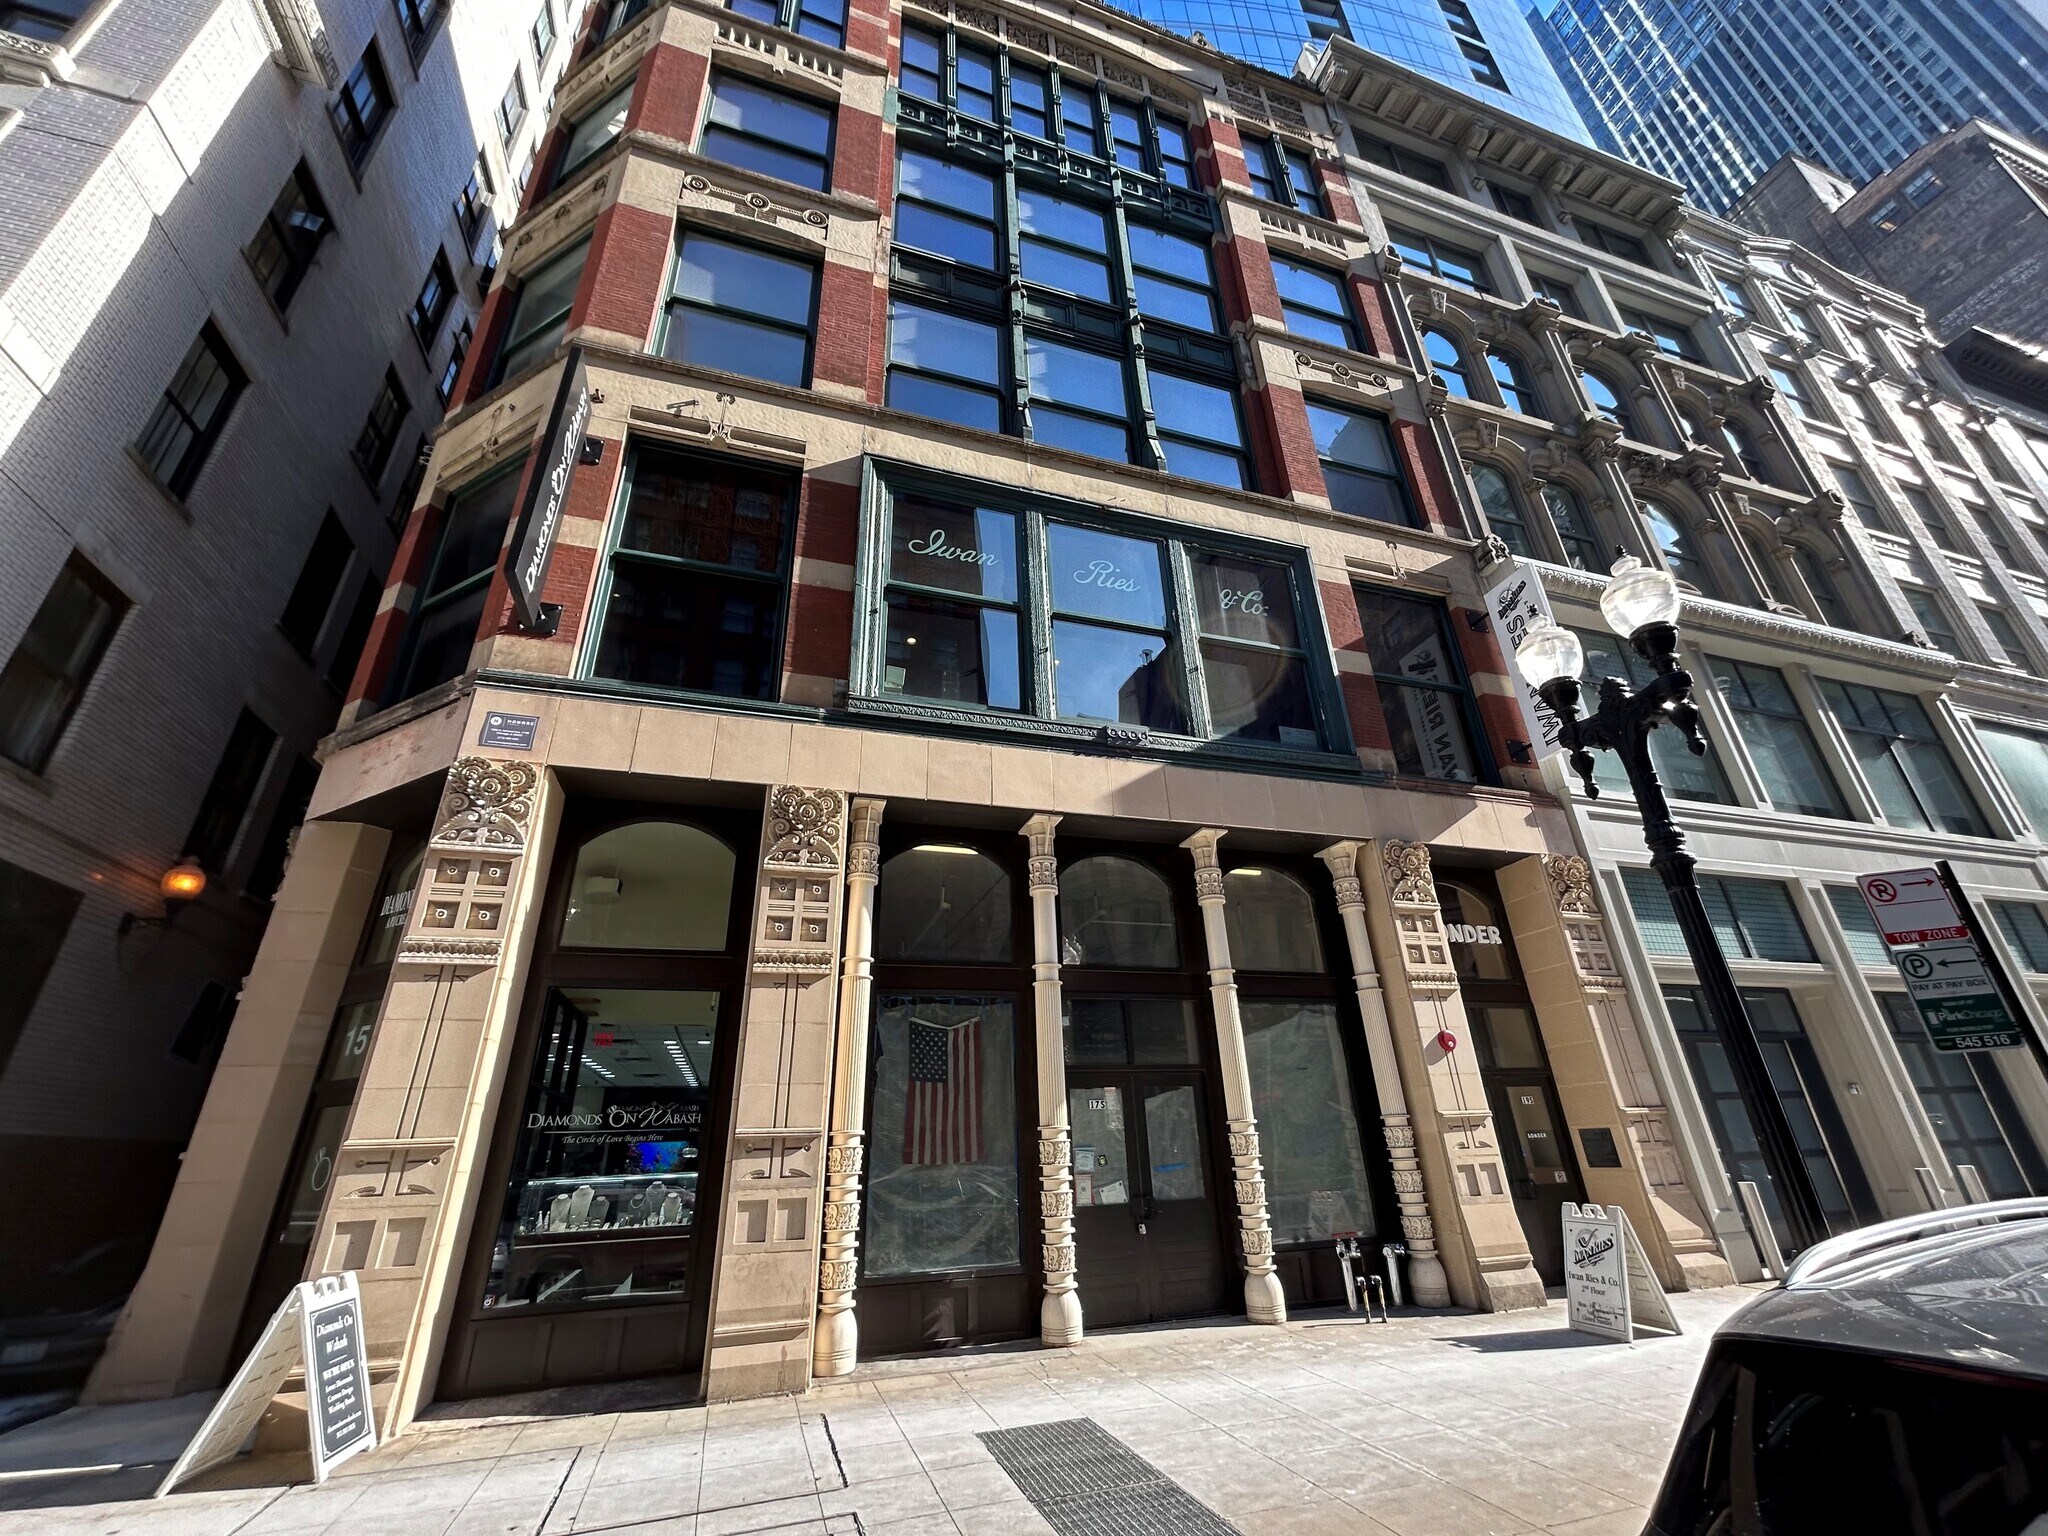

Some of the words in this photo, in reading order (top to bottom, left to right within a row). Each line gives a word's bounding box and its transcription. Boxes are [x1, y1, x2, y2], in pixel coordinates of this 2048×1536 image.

[907, 529, 999, 567] Iwan
[1073, 560, 1140, 593] Ries
[1446, 923, 1502, 945] NDER
[1893, 932, 1921, 943] TOW
[1925, 927, 1960, 940] ZONE
[1912, 983, 1930, 992] PAY
[1945, 980, 1963, 989] PAY
[1965, 978, 1988, 987] BOX
[344, 1024, 371, 1056] 15
[1955, 1036, 1982, 1048] 545
[1983, 1034, 2011, 1046] 516
[562, 1136, 576, 1144] The
[576, 1135, 596, 1144] Circle
[596, 1134, 605, 1145] of
[605, 1134, 623, 1143] Love
[624, 1133, 647, 1144] Begins
[647, 1133, 664, 1142] Here
[1568, 1270, 1584, 1281] Iwan
[1585, 1273, 1599, 1284] Ries
[1600, 1275, 1607, 1285] &
